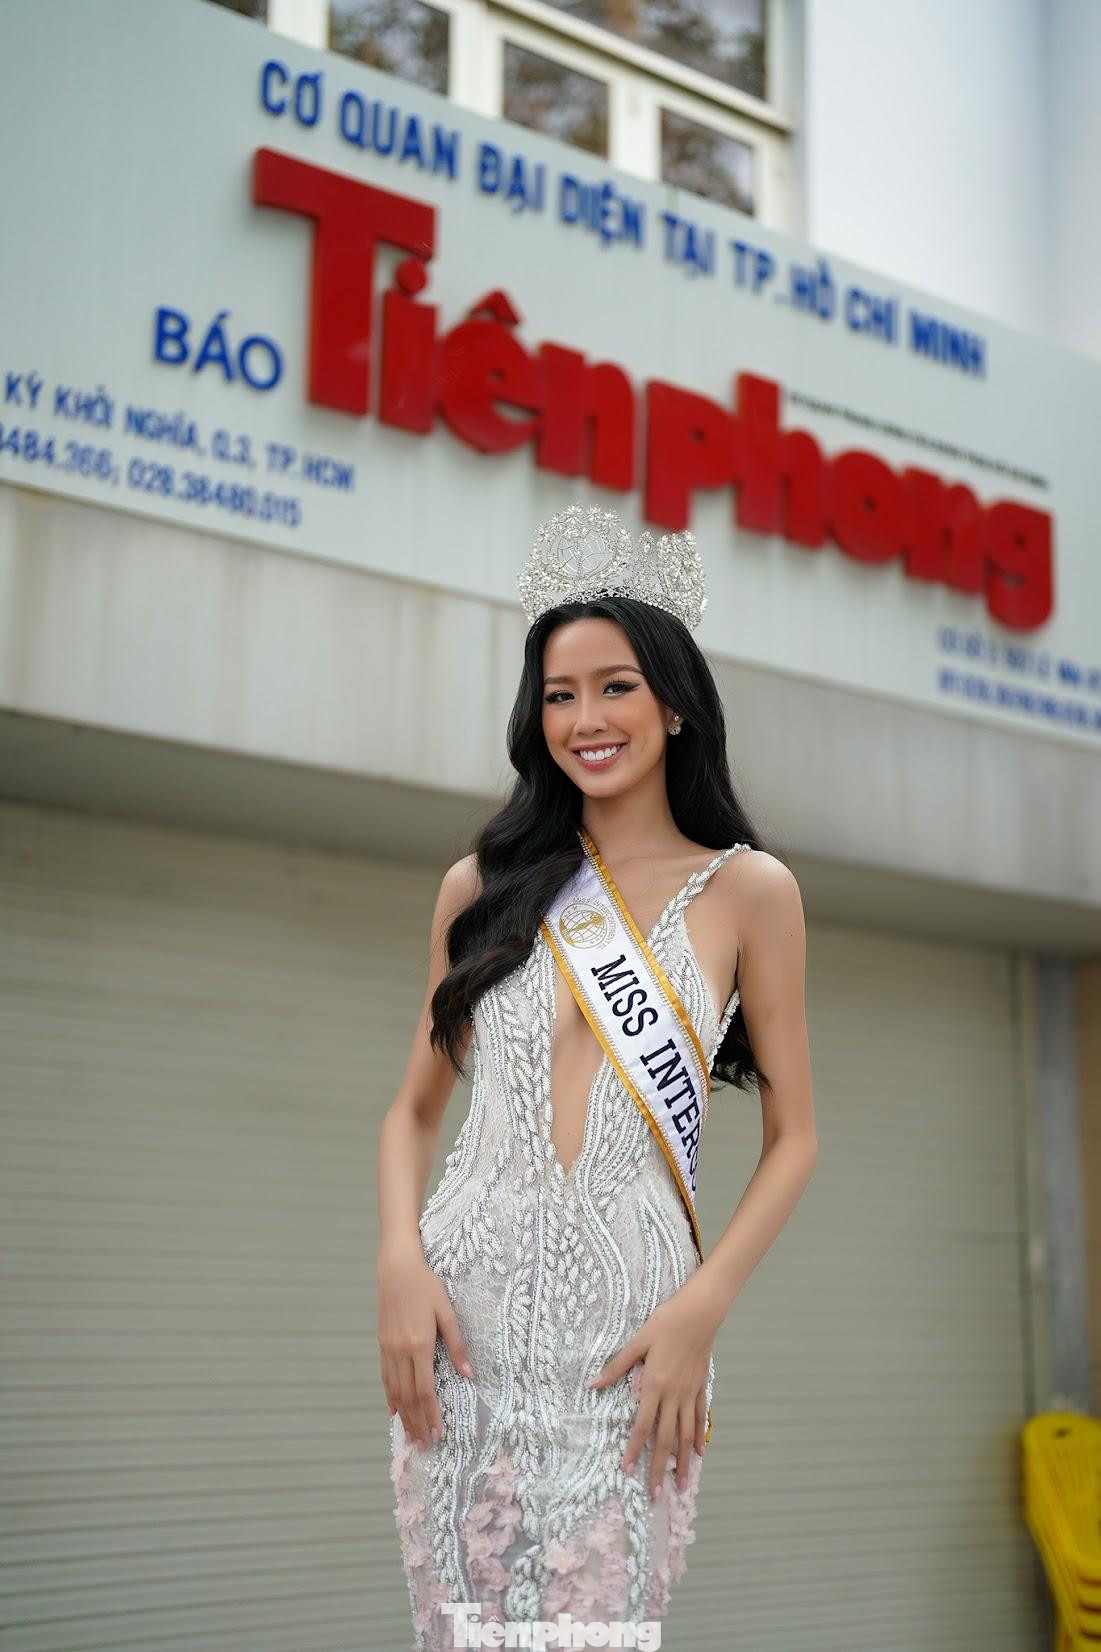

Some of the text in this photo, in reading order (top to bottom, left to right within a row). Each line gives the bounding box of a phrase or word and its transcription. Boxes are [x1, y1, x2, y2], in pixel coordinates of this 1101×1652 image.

[260, 59, 324, 128] CƠ
[340, 89, 459, 181] QUAN
[479, 140, 545, 214] ĐẠI
[559, 173, 645, 248] DIỆN
[661, 209, 717, 279] TẠI
[908, 309, 987, 380] MINH
[154, 306, 285, 392] BÁO
[590, 954, 659, 1037] MISS
